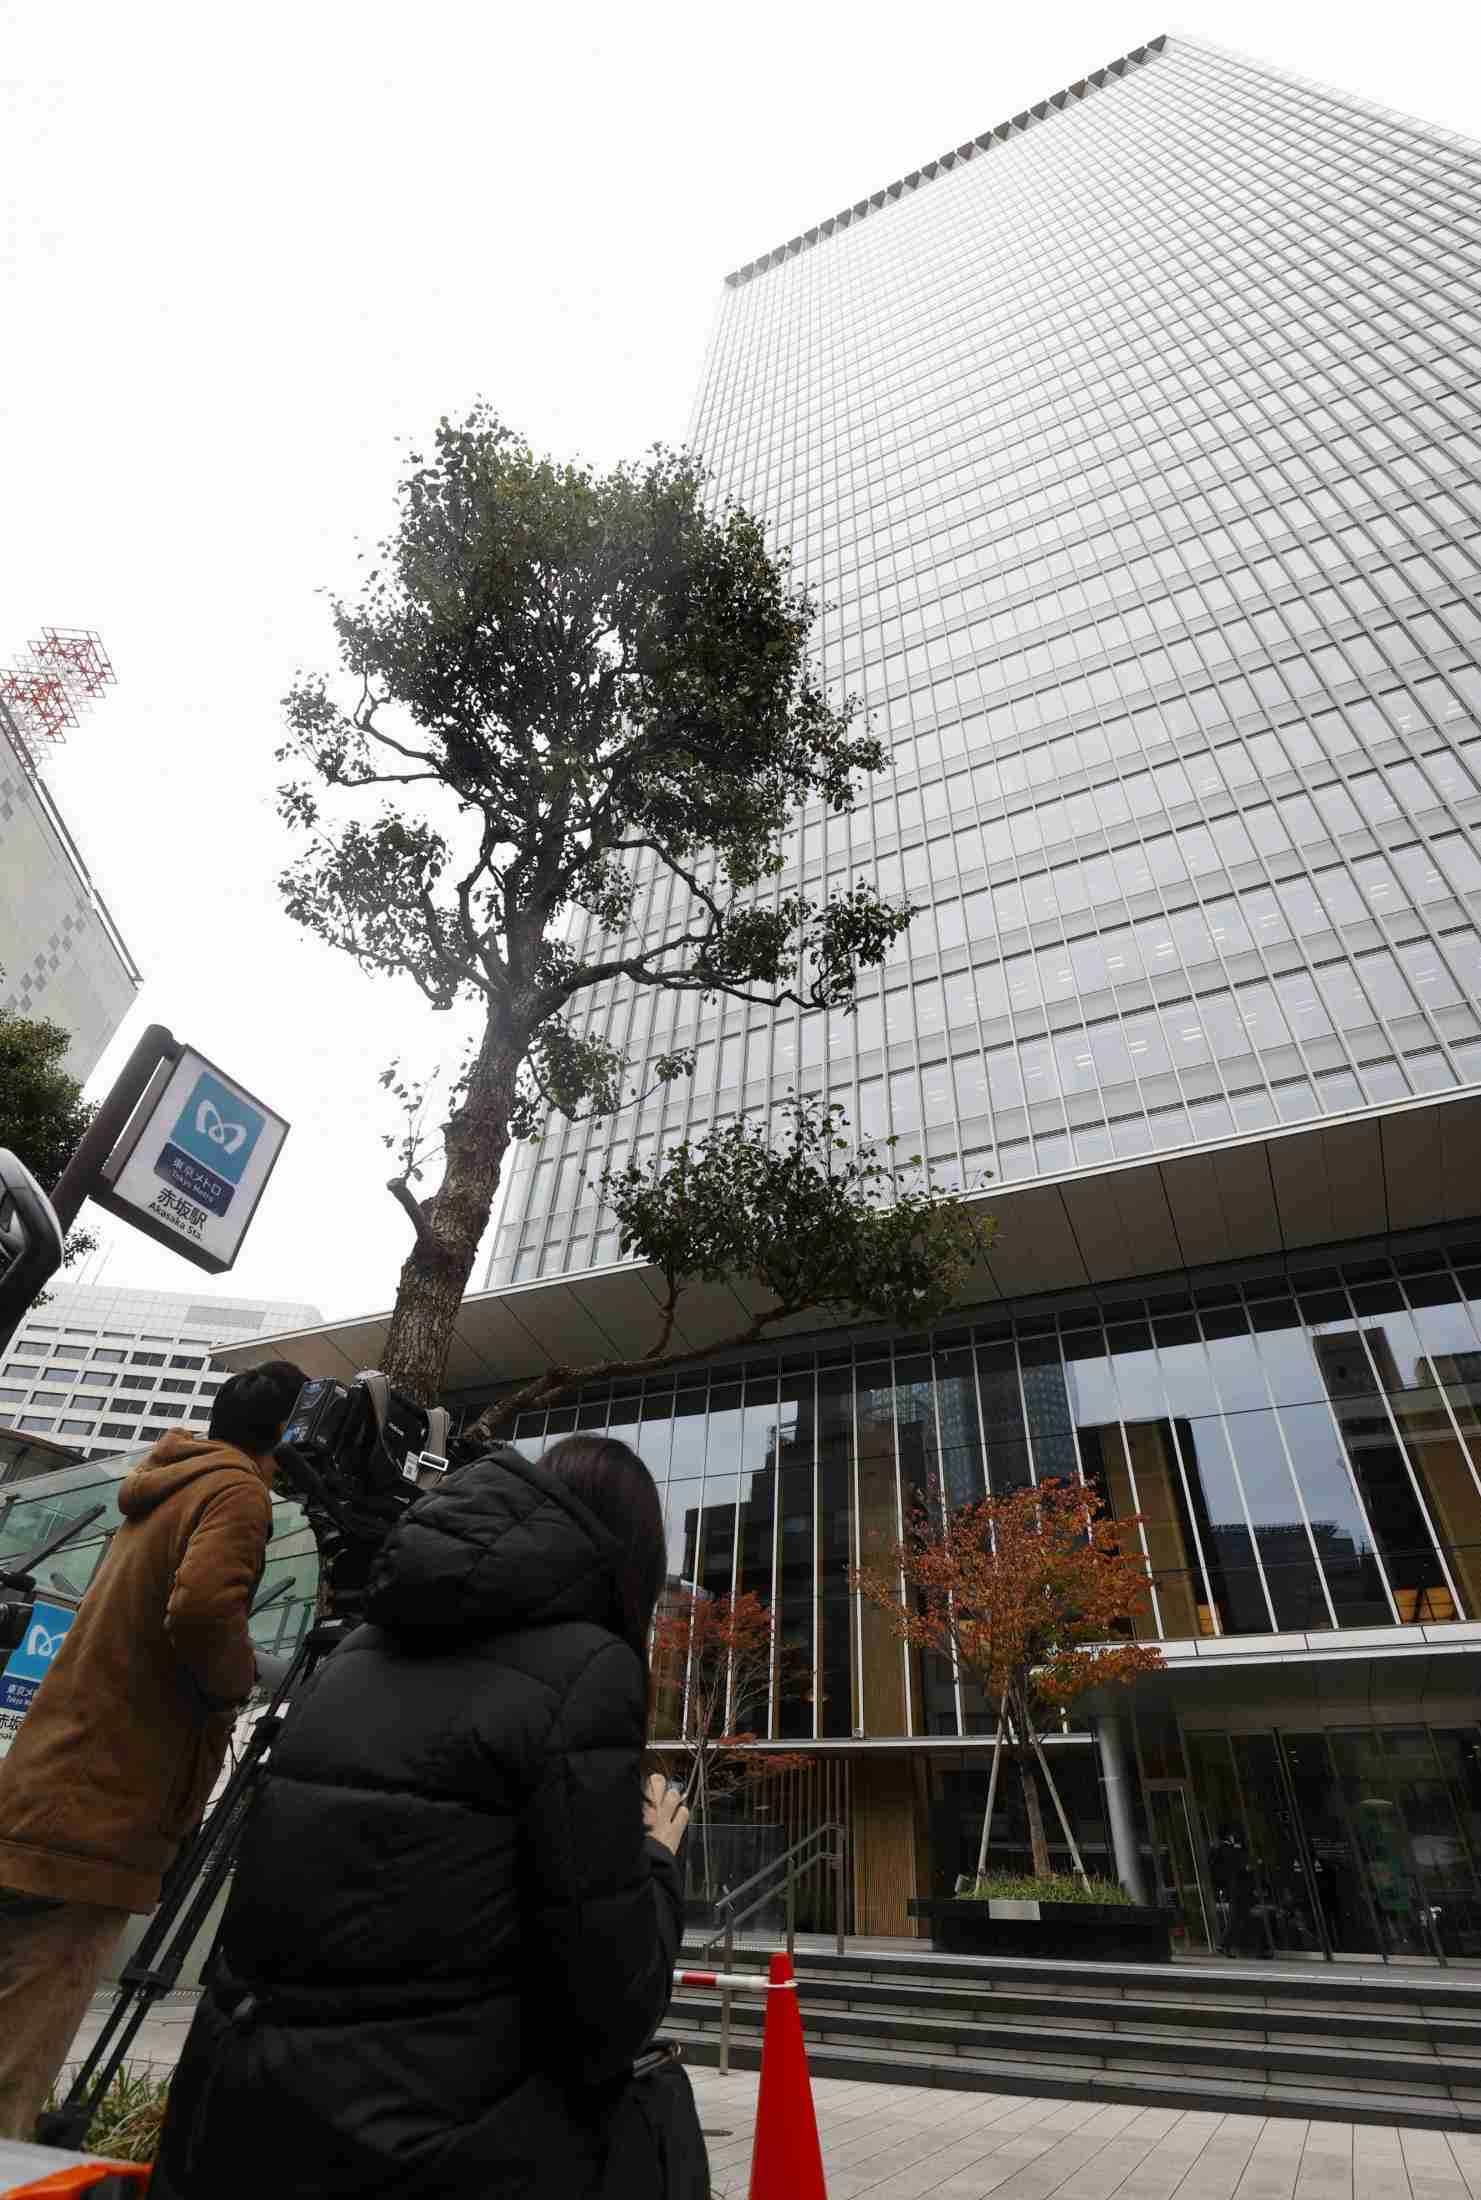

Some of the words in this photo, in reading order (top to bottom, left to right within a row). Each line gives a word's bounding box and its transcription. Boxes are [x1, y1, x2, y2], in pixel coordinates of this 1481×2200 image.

[172, 1158, 222, 1196] 東京メトロ
[148, 1202, 186, 1230] Akasaka
[157, 1187, 208, 1229] 赤坂駅
[8, 1684, 33, 1697] 東京メ
